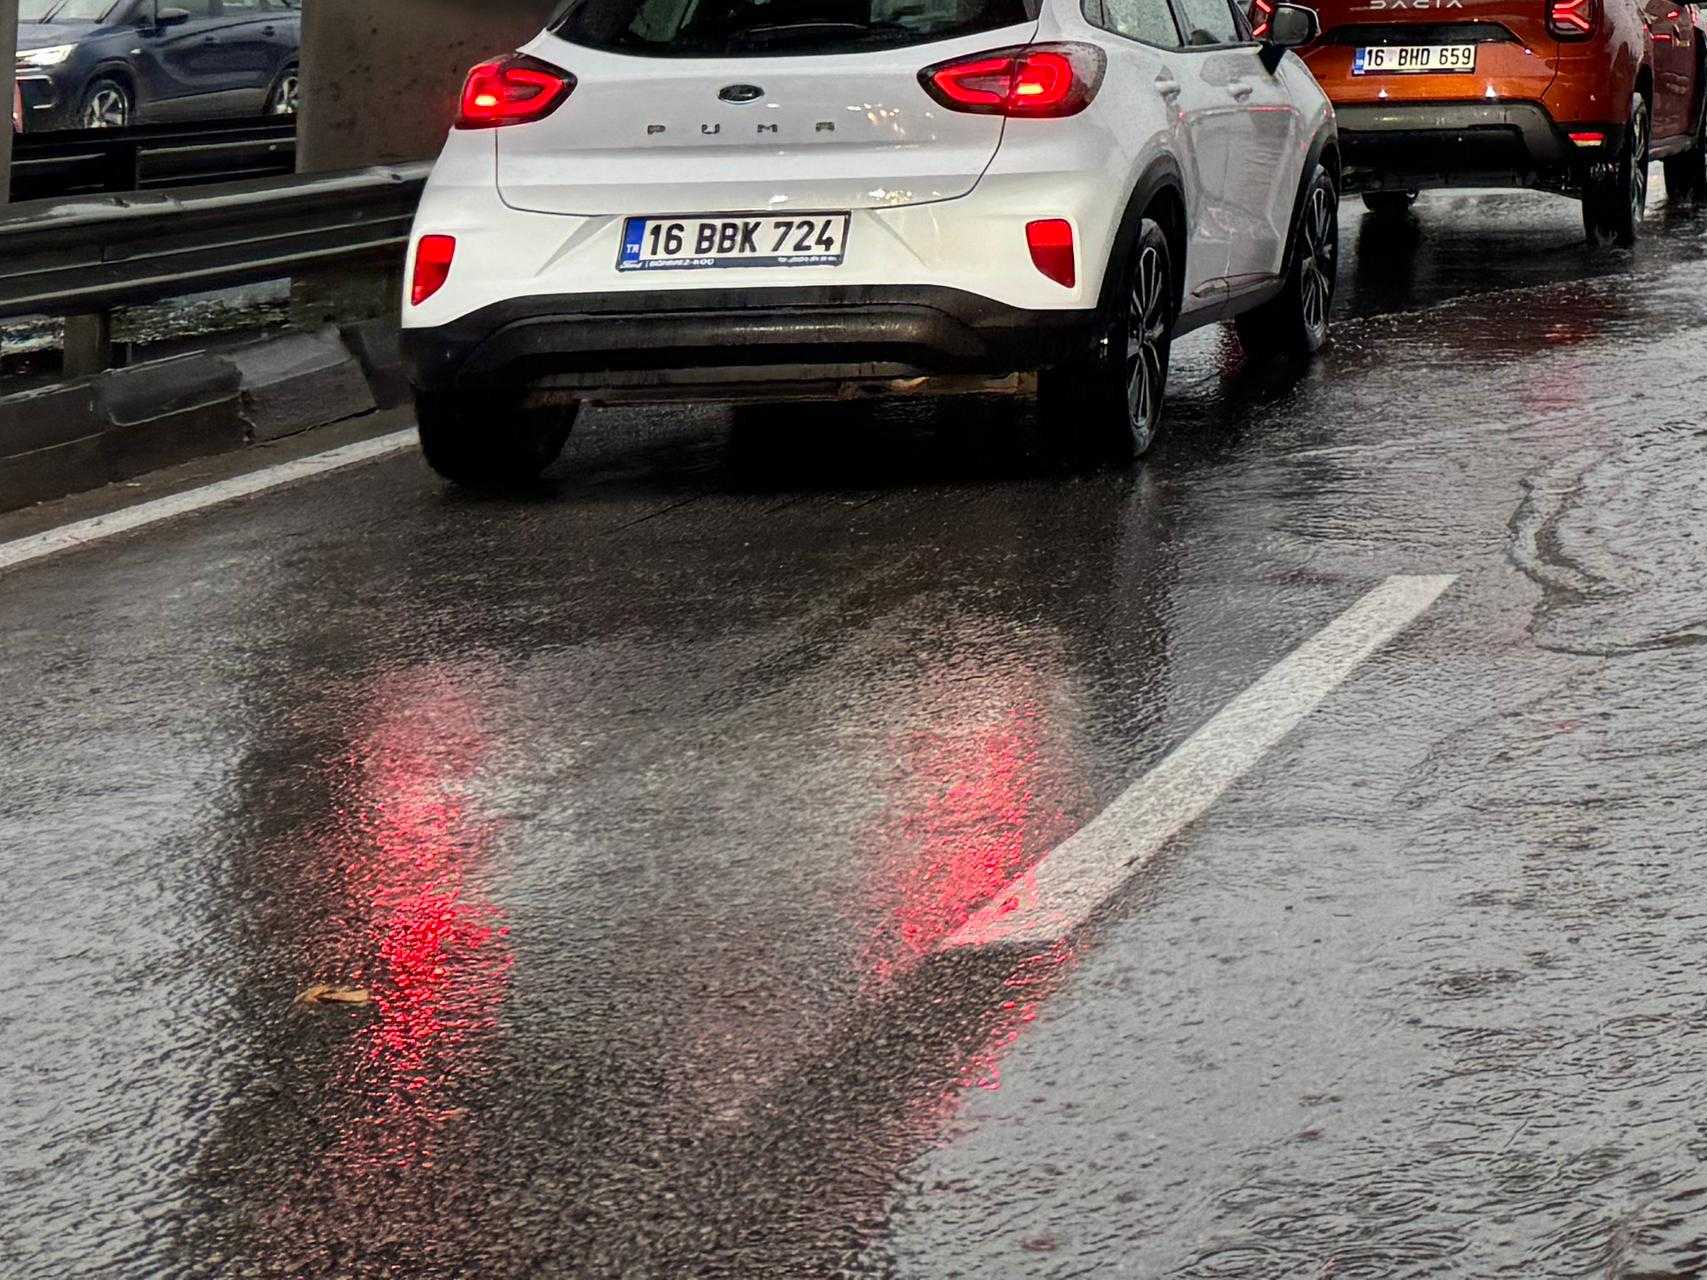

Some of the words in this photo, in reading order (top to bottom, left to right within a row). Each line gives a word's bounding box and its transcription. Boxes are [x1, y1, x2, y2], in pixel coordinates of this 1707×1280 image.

[1366, 48, 1385, 66] 16
[1398, 48, 1431, 66] BHD
[1439, 47, 1472, 65] 659
[647, 121, 836, 135] PUMA
[649, 222, 685, 256] 16
[694, 220, 762, 255] BBK
[771, 219, 835, 252] 724
